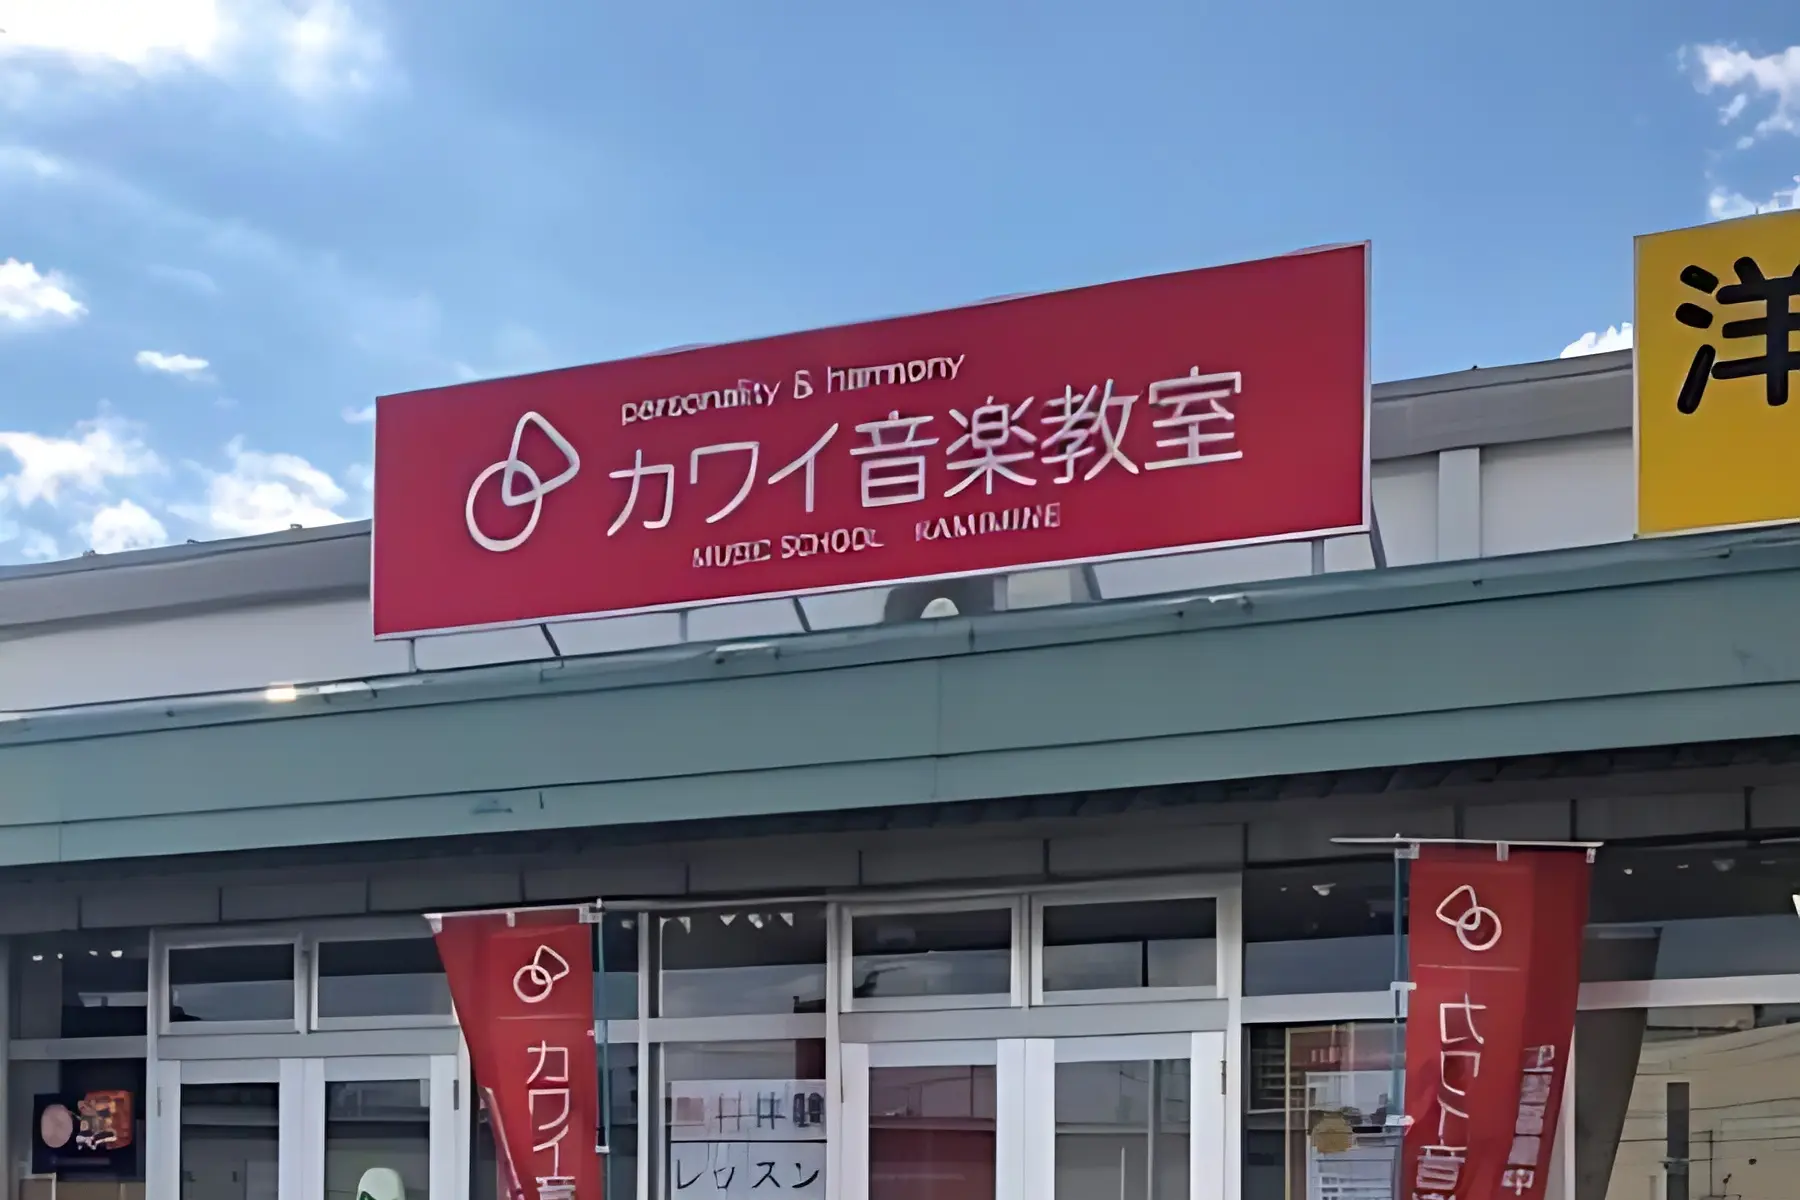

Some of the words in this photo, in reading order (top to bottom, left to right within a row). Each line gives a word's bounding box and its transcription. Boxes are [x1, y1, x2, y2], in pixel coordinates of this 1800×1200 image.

[1675, 256, 1800, 415] 洋
[607, 366, 1243, 537] カワイ音楽教室
[780, 526, 884, 559] SCHOOL
